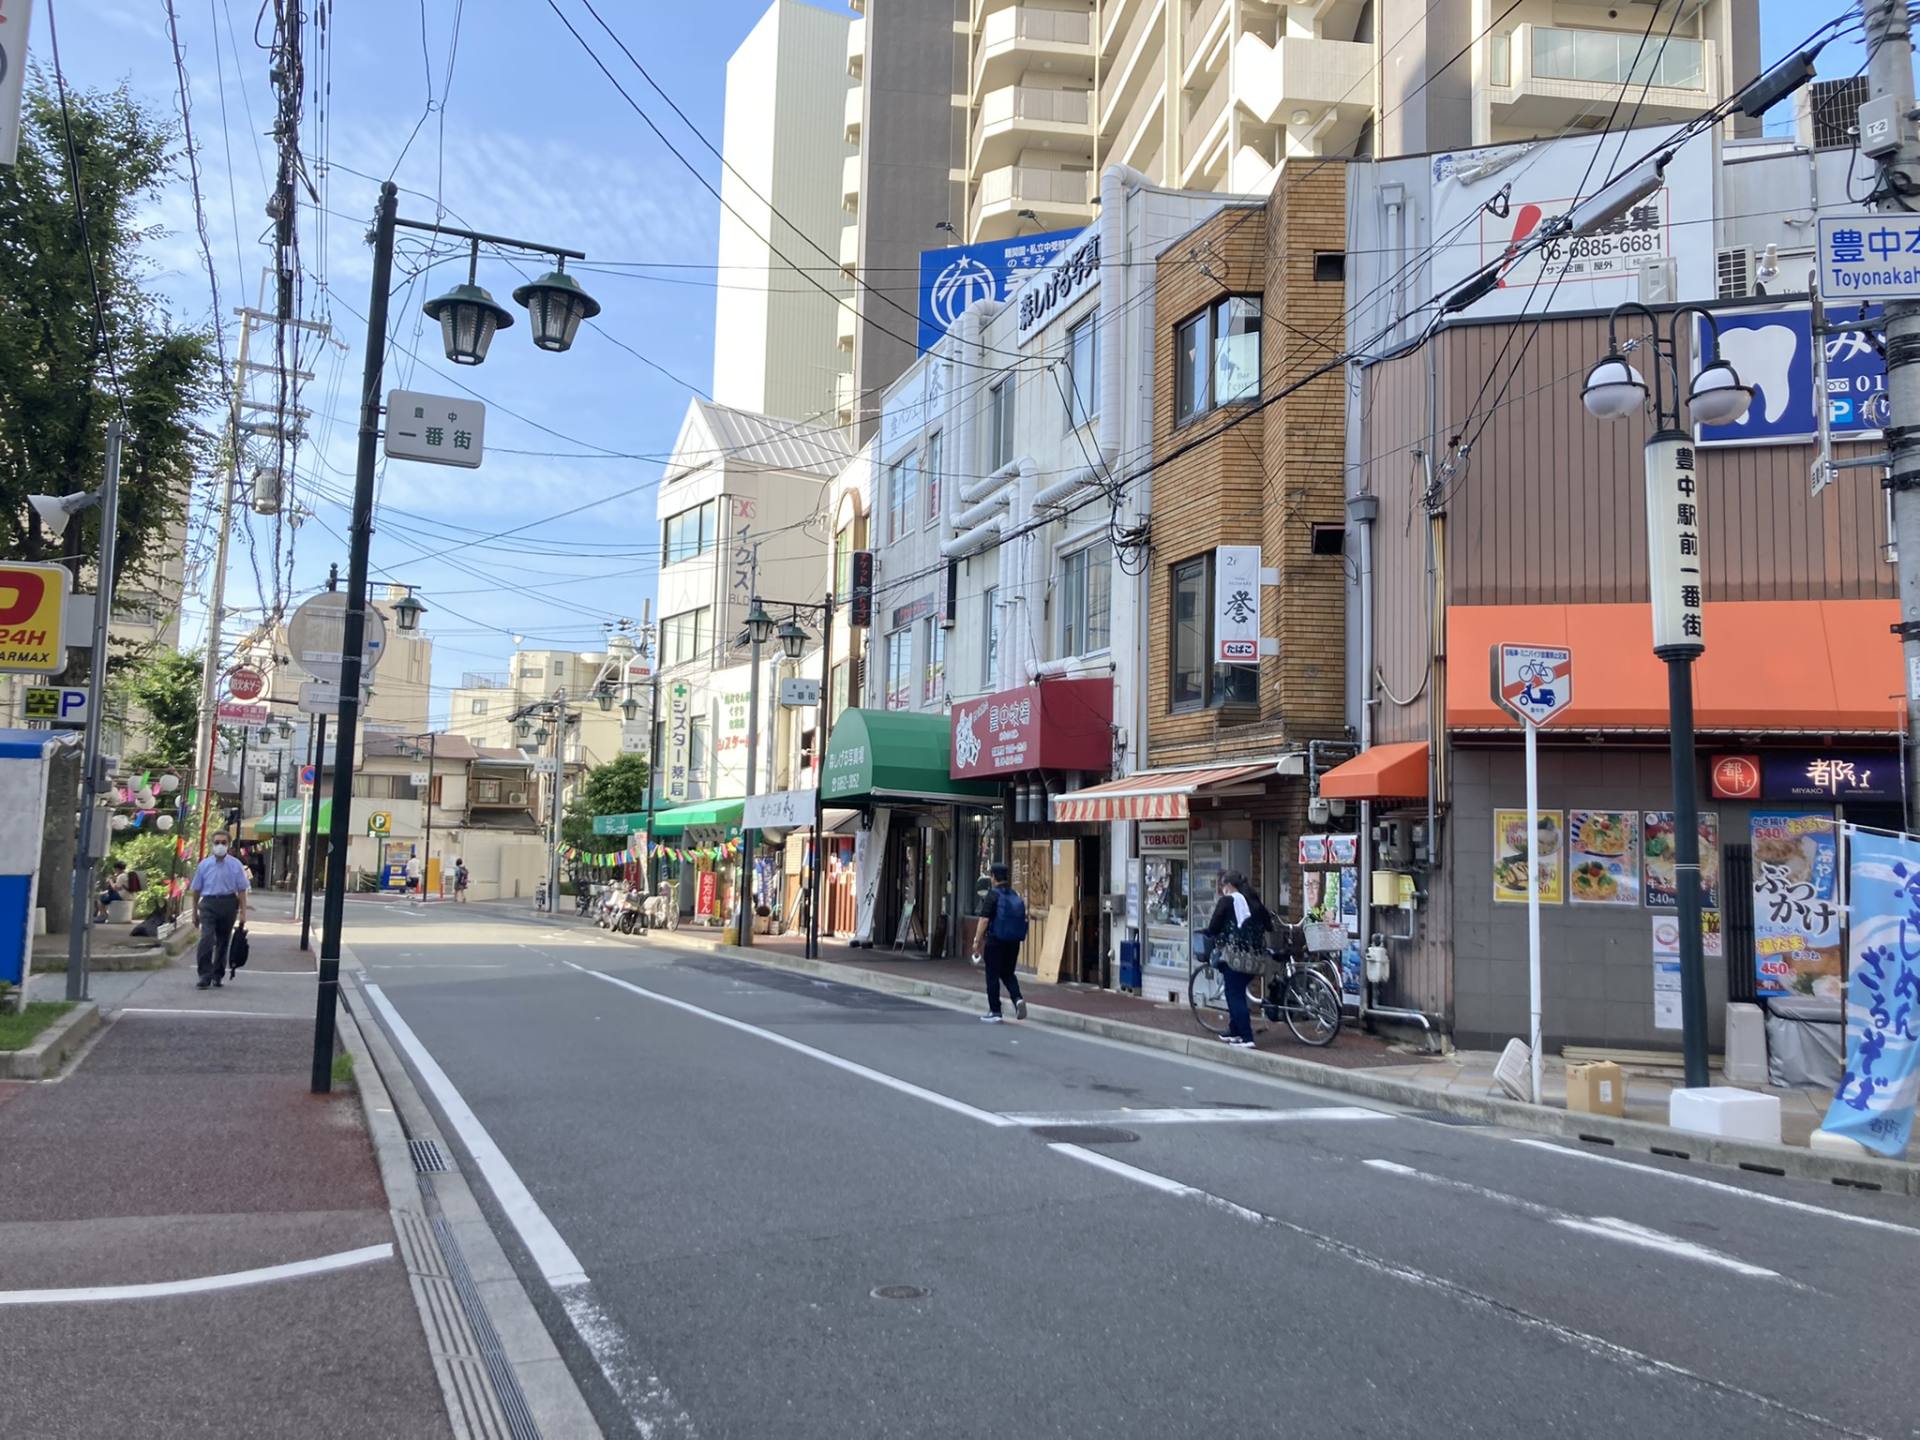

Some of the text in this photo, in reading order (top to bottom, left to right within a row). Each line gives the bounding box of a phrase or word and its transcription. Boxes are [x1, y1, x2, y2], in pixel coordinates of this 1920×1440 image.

[1868, 120, 1887, 134] T-2
[1540, 233, 1661, 261] 06-6885-6681
[399, 426, 472, 450] 一番街
[1675, 447, 1702, 638] 豊中駅前一番街
[734, 523, 752, 590] イクス
[1226, 644, 1253, 655] たばこ
[61, 691, 87, 718] P
[670, 700, 688, 796] シスター薬局
[1143, 834, 1186, 846] TOBACCO
